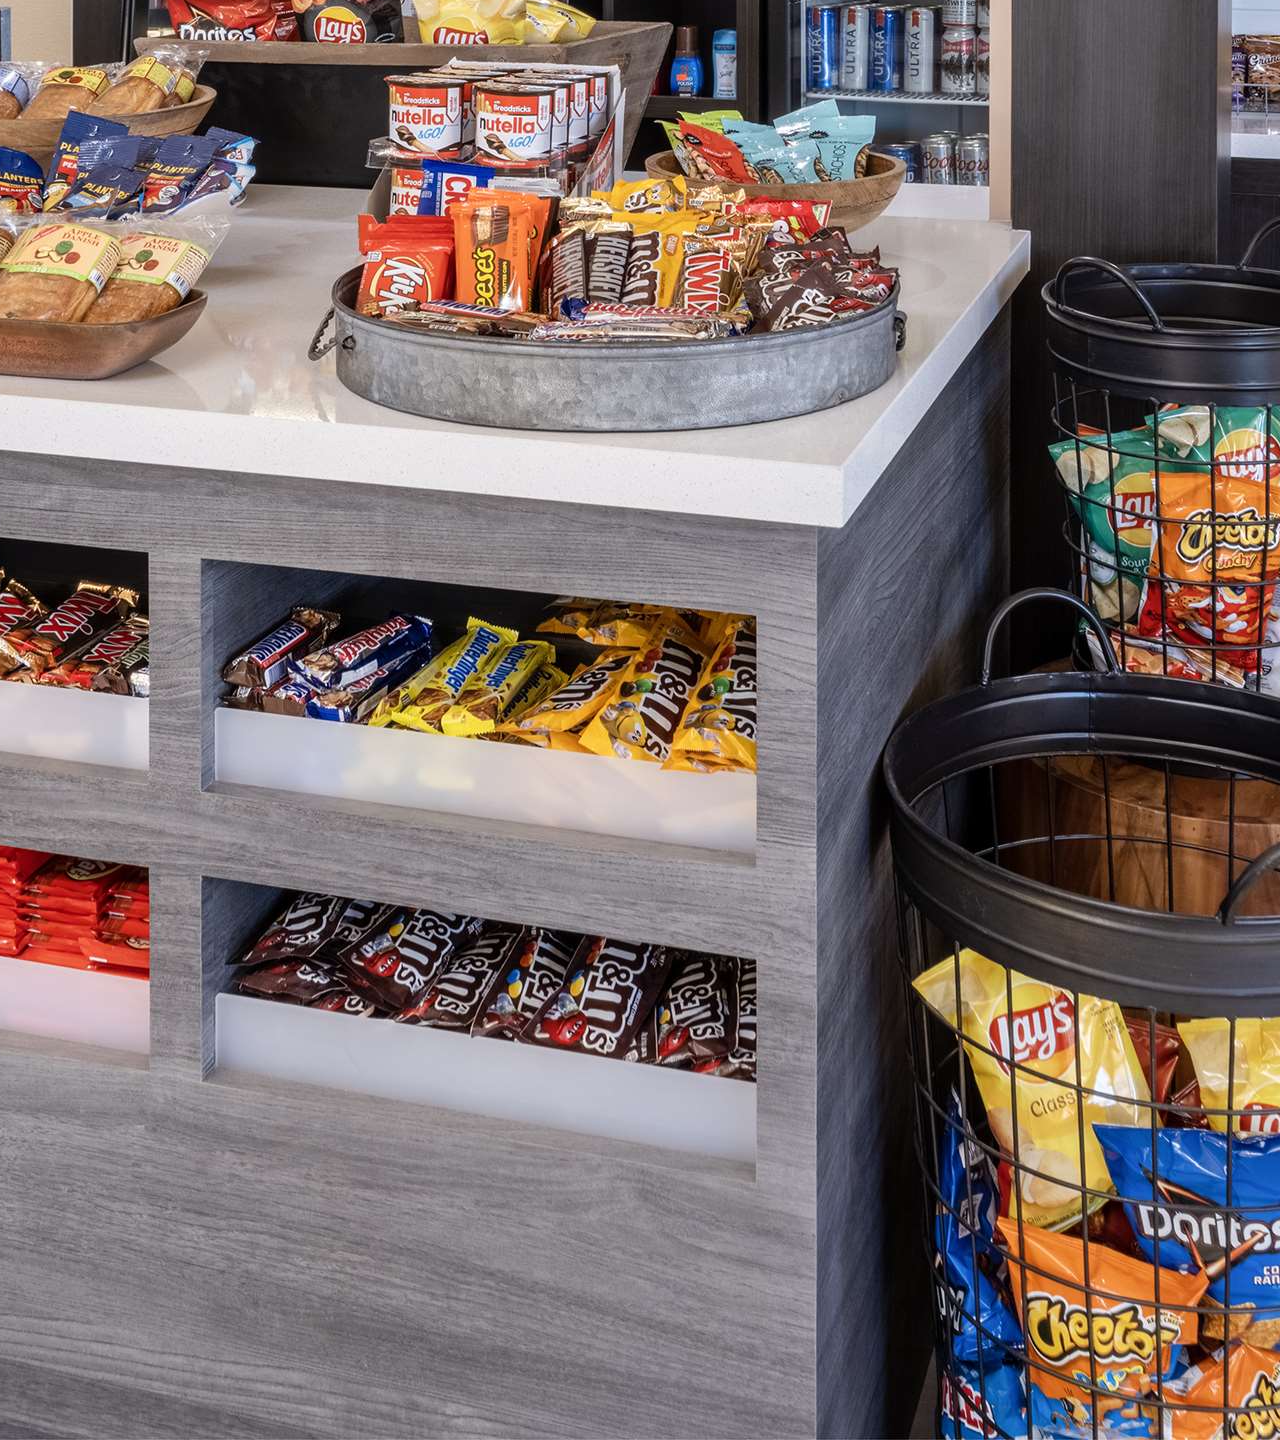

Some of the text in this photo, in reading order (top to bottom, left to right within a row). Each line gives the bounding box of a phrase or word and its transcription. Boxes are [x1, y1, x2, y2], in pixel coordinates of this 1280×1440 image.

[317, 17, 364, 44] Lay's
[812, 27, 821, 75] ULTRA
[846, 28, 857, 75] ULTRA
[874, 29, 884, 76] ULTRA
[909, 29, 920, 78] ULTRA
[403, 95, 441, 105] Breadsticks
[493, 102, 532, 113] Breadsticks
[391, 109, 444, 126] nutella
[479, 114, 536, 134] nutella
[149, 161, 198, 177] PLANTERS
[0, 185, 39, 195] PEANUTS
[146, 176, 178, 187] PEANUTS
[62, 232, 100, 247] DANISH
[69, 227, 100, 241] APPLE
[150, 237, 180, 248] APPLE
[143, 241, 180, 253] DANISH
[1178, 508, 1280, 561] Cheetos
[1121, 556, 1149, 568] Sour
[35, 589, 119, 641] TWIX
[254, 621, 306, 660] SNICKERS
[444, 626, 501, 693] Butterfinger
[994, 998, 1074, 1064] Lay's
[1027, 1292, 1181, 1360] Cheetos
